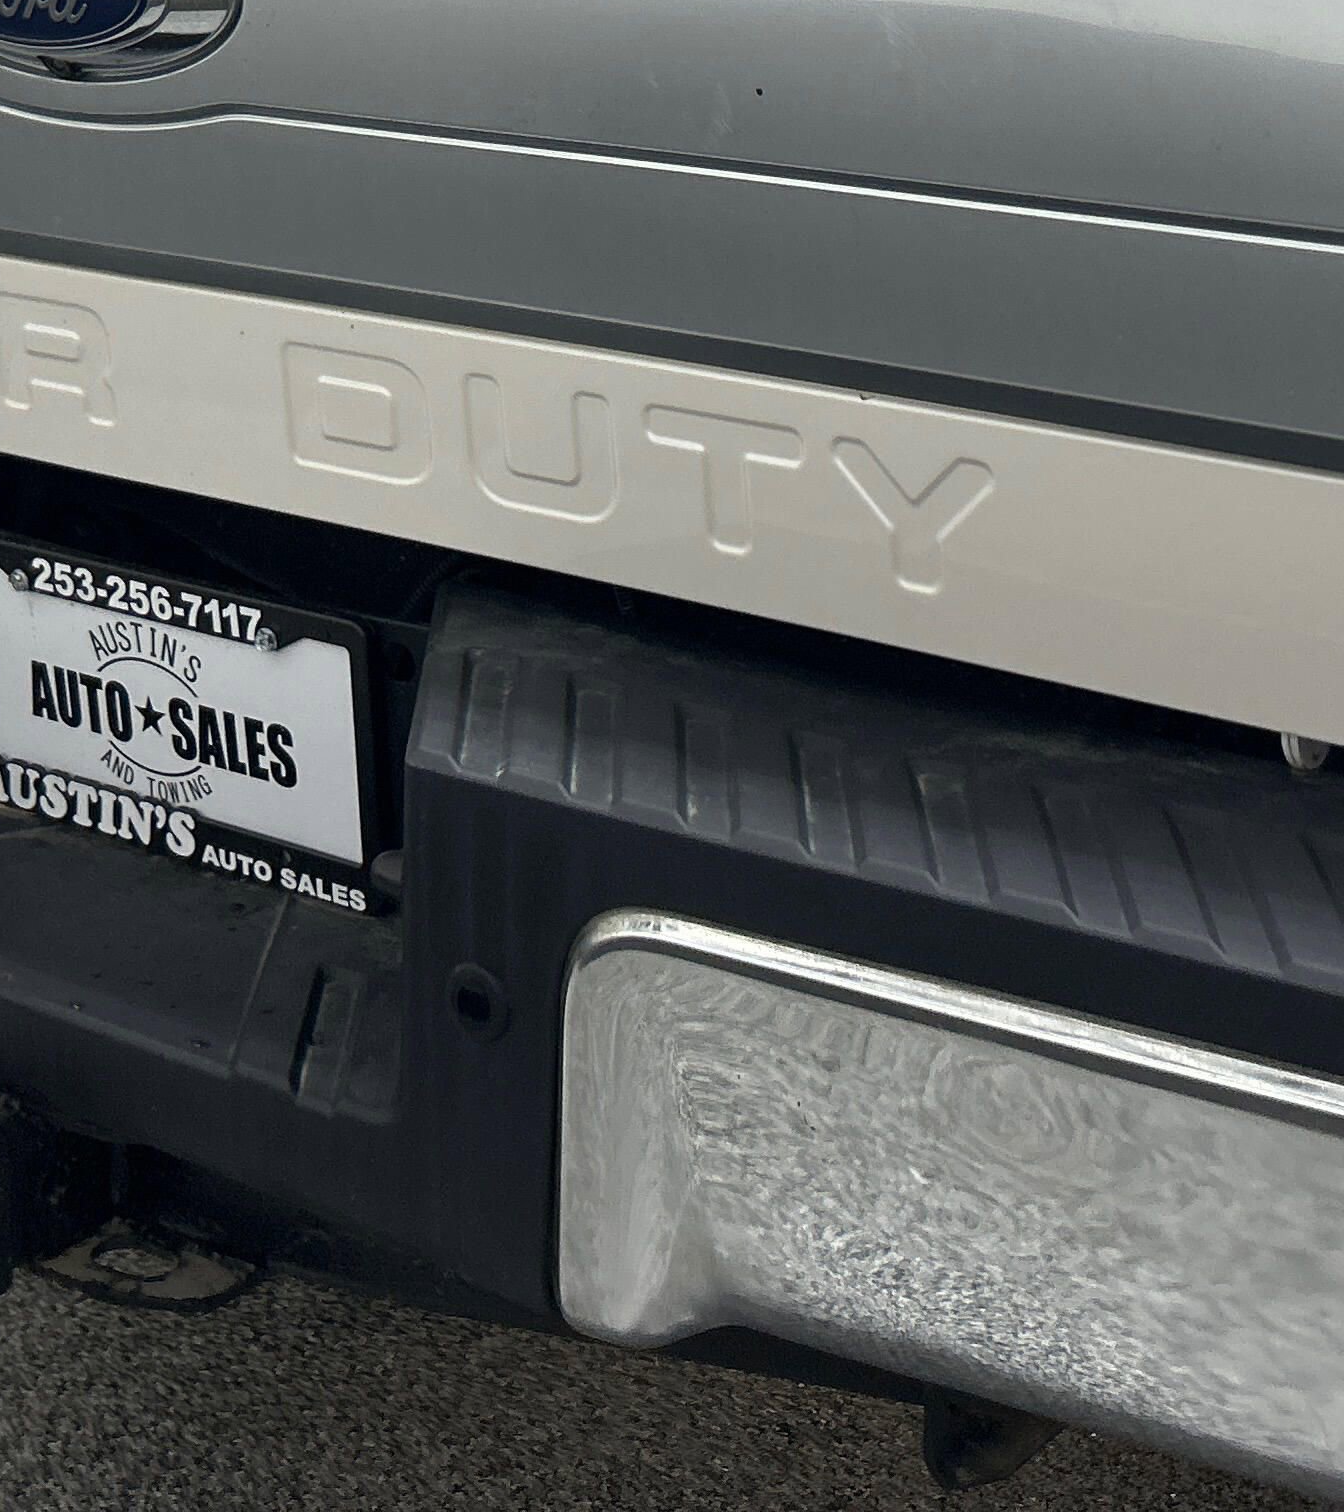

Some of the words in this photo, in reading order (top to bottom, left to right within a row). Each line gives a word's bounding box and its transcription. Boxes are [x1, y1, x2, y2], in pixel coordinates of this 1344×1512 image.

[281, 341, 996, 595] DUTY
[31, 556, 264, 641] 253-256-7117
[87, 620, 203, 684] AUSTIN'S
[30, 659, 134, 744] AUTO
[168, 696, 298, 789] SALES
[100, 747, 135, 787] AND
[146, 772, 213, 804] TOWING
[201, 843, 273, 883] AUTO
[279, 867, 367, 913] SALES
